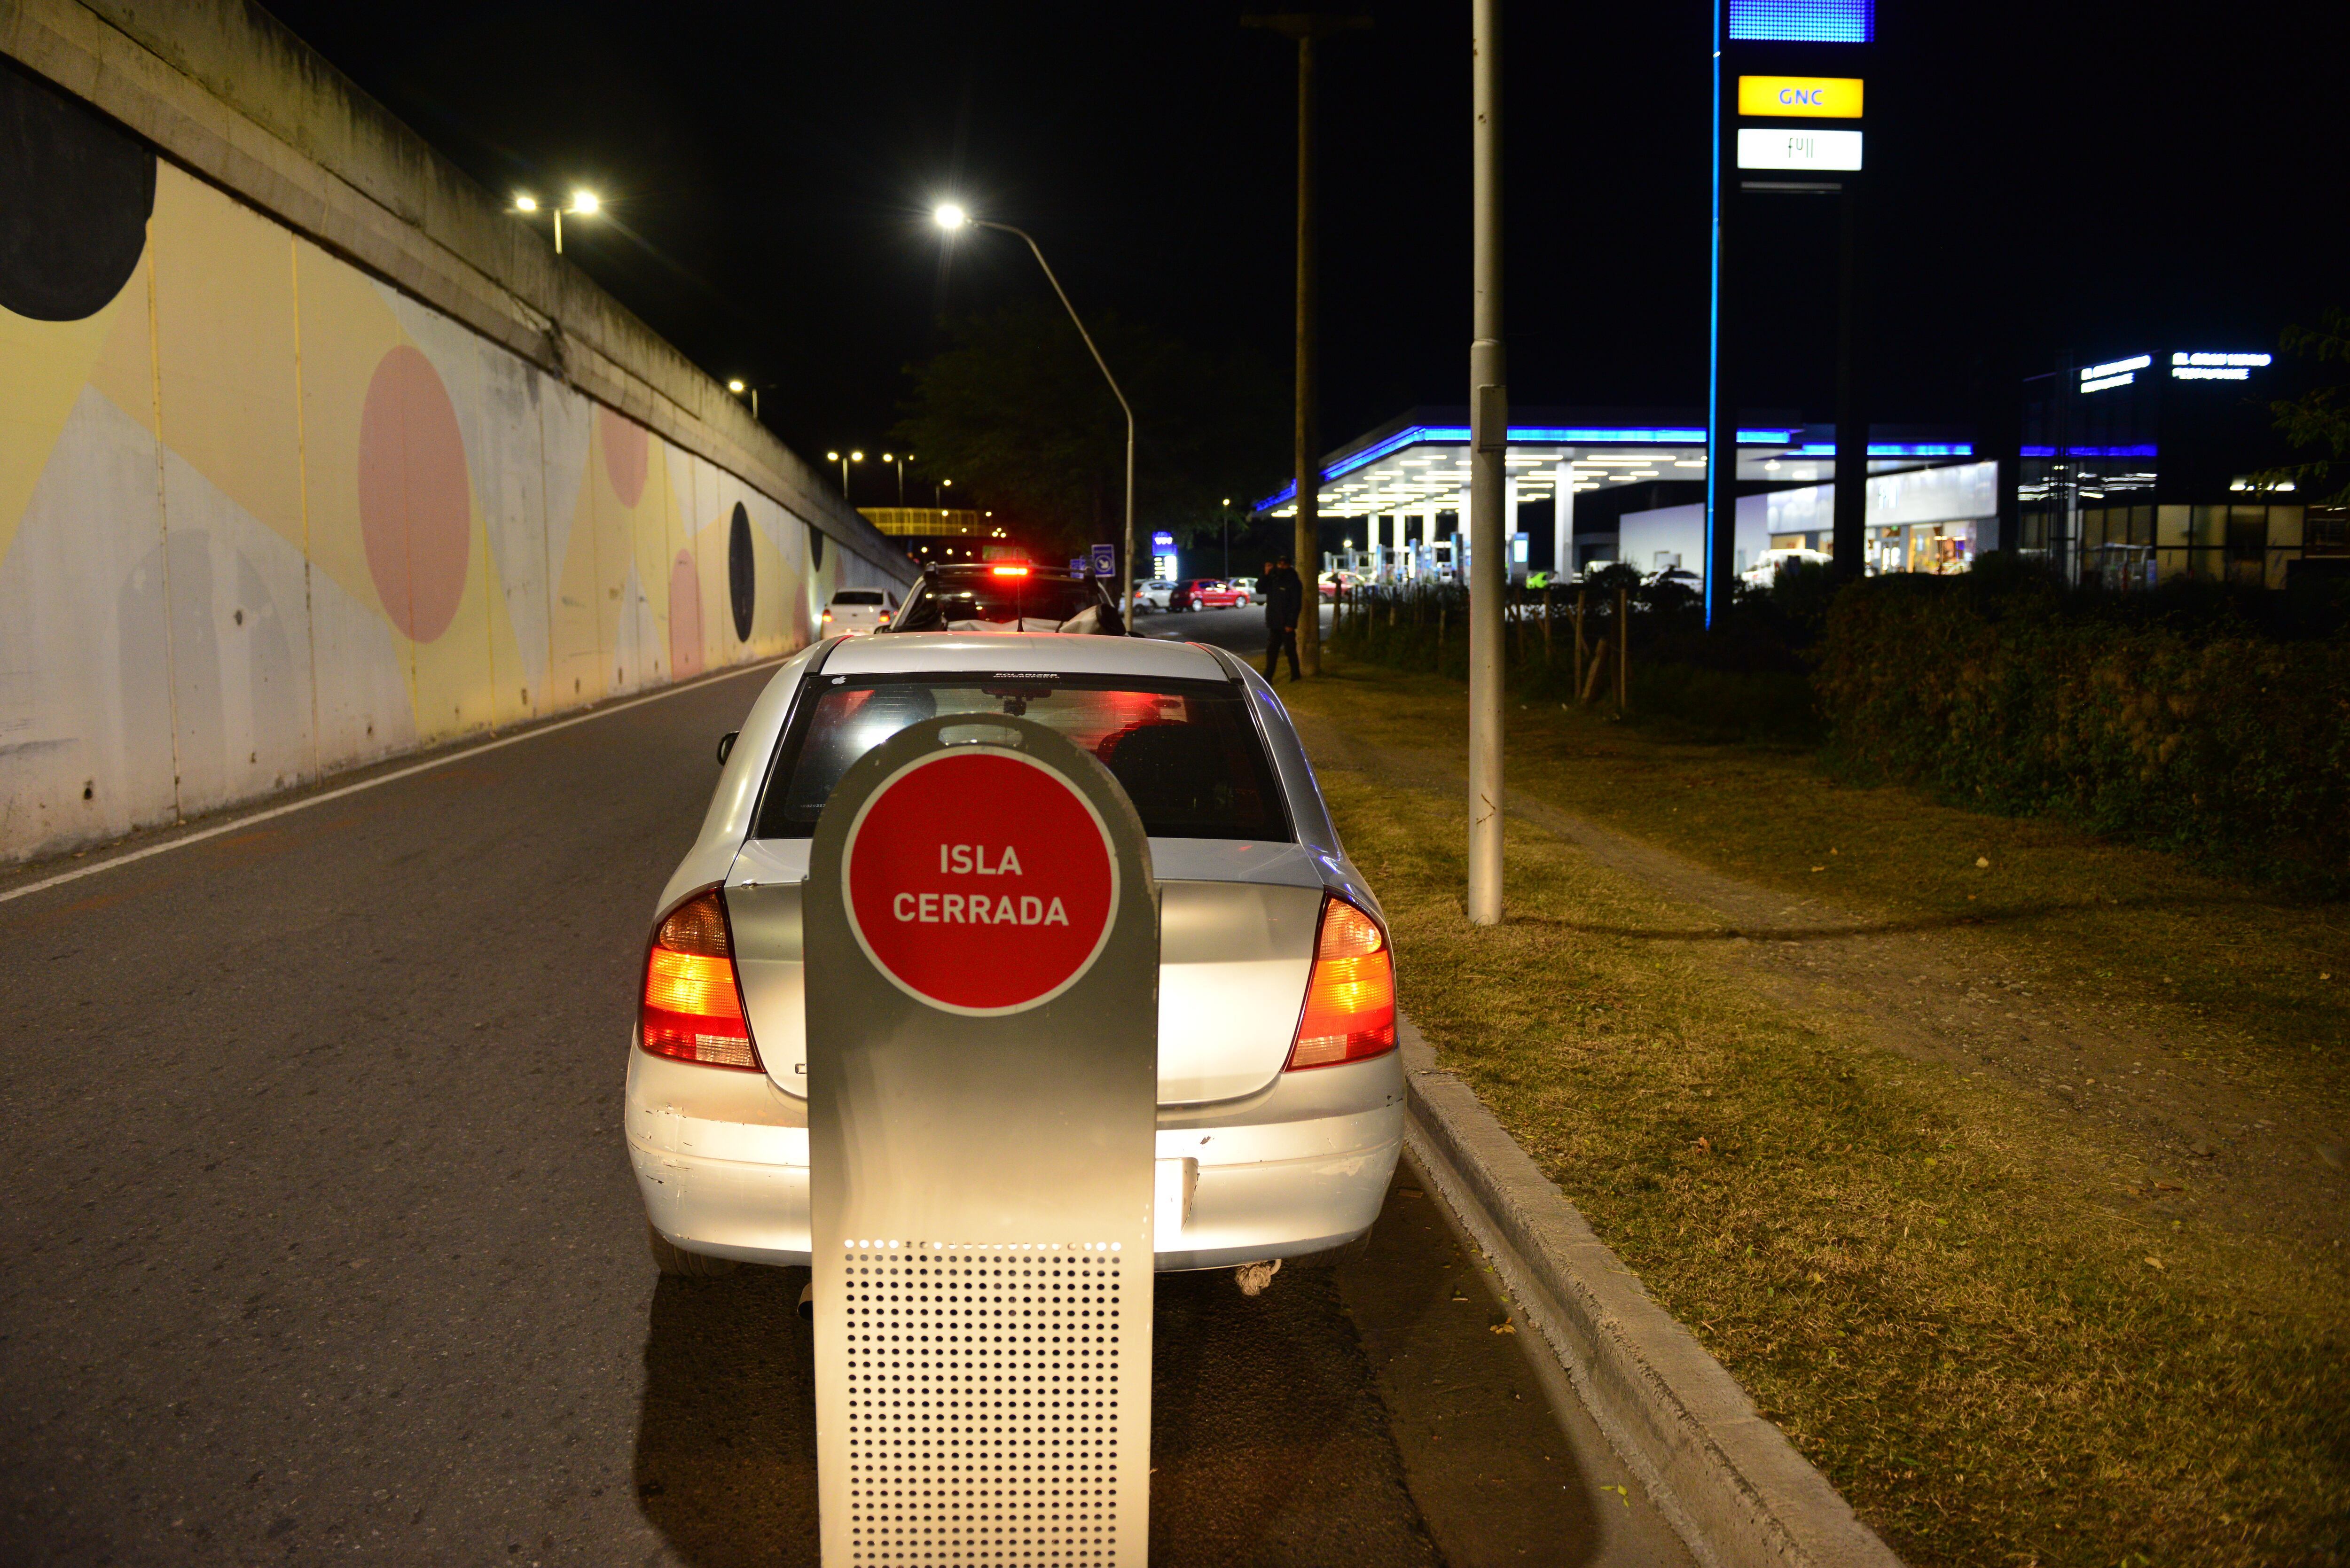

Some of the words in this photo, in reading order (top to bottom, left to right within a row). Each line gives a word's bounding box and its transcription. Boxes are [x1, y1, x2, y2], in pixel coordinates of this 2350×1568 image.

[1779, 88, 1823, 105] GNC
[1788, 138, 1814, 158] full
[940, 844, 1023, 875] ISLA
[893, 892, 1069, 926] CERRADA
